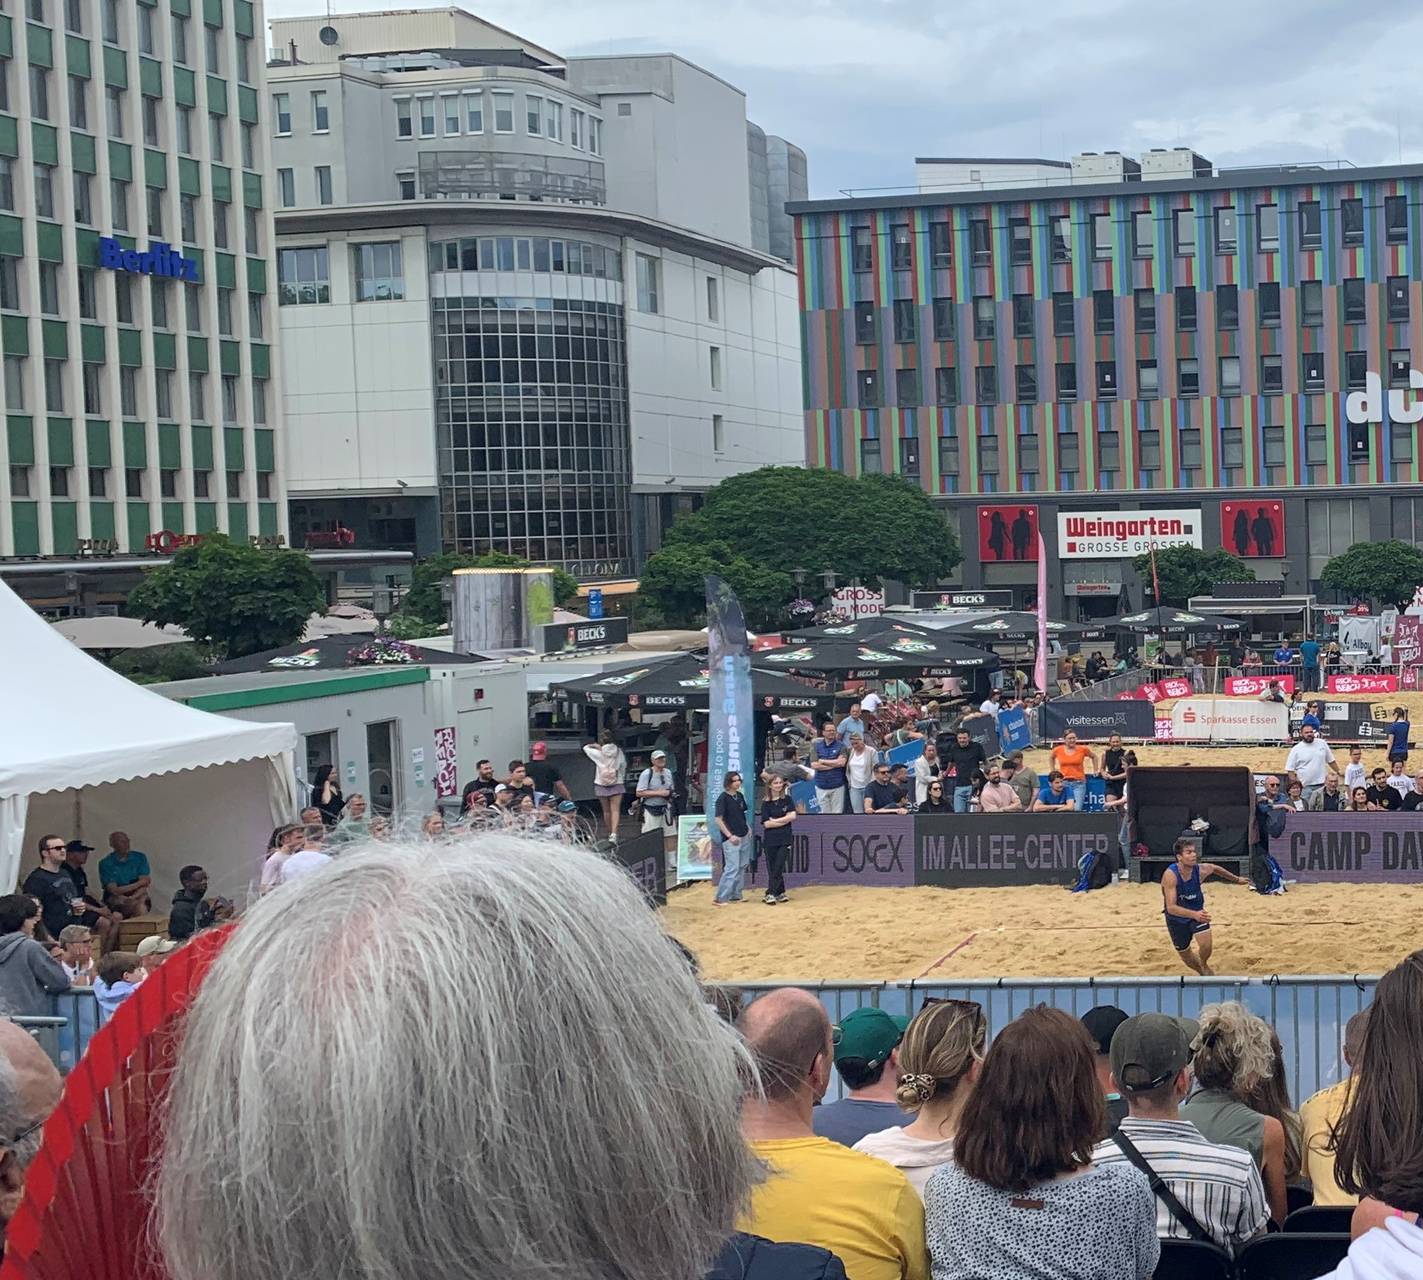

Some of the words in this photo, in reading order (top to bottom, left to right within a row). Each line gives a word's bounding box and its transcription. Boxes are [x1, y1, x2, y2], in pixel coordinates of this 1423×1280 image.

[100, 236, 199, 281] Berlitz
[1078, 542, 1128, 553] GROSSE
[836, 588, 883, 600] GROSS
[952, 594, 985, 604] BECK'S
[850, 604, 884, 614] MODE
[577, 626, 606, 641] BECK'S
[1352, 638, 1371, 649] Allbau
[646, 696, 686, 704] BECK'S
[780, 698, 817, 706] BECK'S
[1066, 713, 1114, 726] visitessen
[1201, 714, 1248, 726] Sparkasse
[1250, 715, 1277, 724] Essen
[443, 728, 456, 770] ROCK
[434, 730, 451, 796] BEACH
[922, 836, 946, 870] IM
[950, 834, 1109, 870] ALLEE-CENTER
[1290, 831, 1371, 871] CAMP
